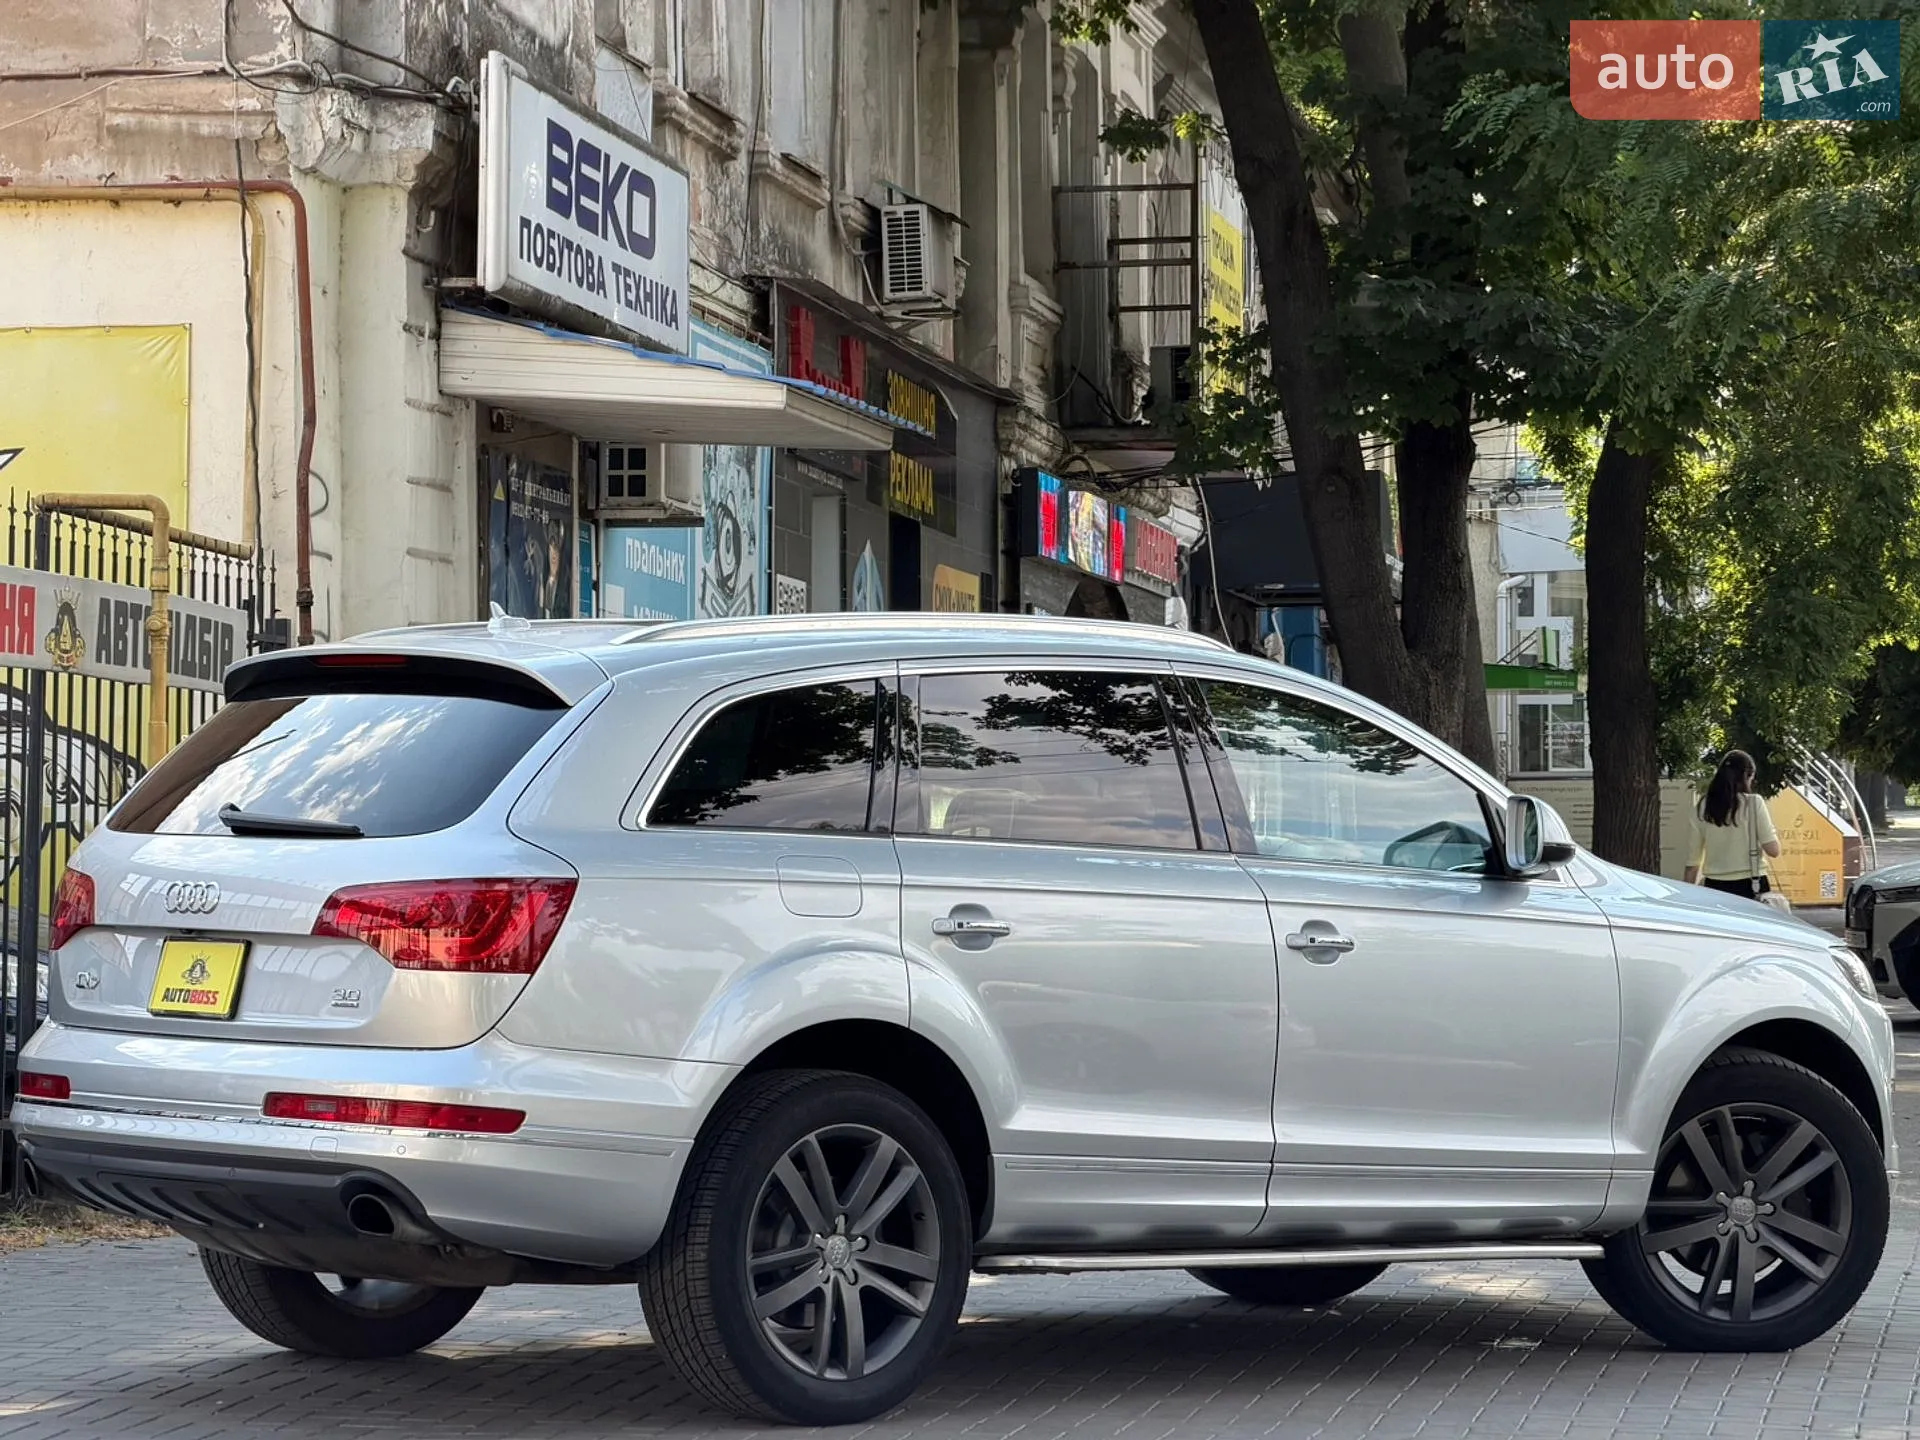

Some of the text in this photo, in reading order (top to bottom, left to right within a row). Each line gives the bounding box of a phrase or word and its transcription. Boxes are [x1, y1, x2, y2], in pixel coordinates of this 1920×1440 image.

[546, 117, 656, 260] BEKO
[519, 215, 680, 331] ПОБУТОВА ТЕХНІКА
[890, 449, 934, 515] РЕКЛАМА
[625, 535, 685, 585] пральних
[161, 987, 219, 1005] AUTOBOSS
